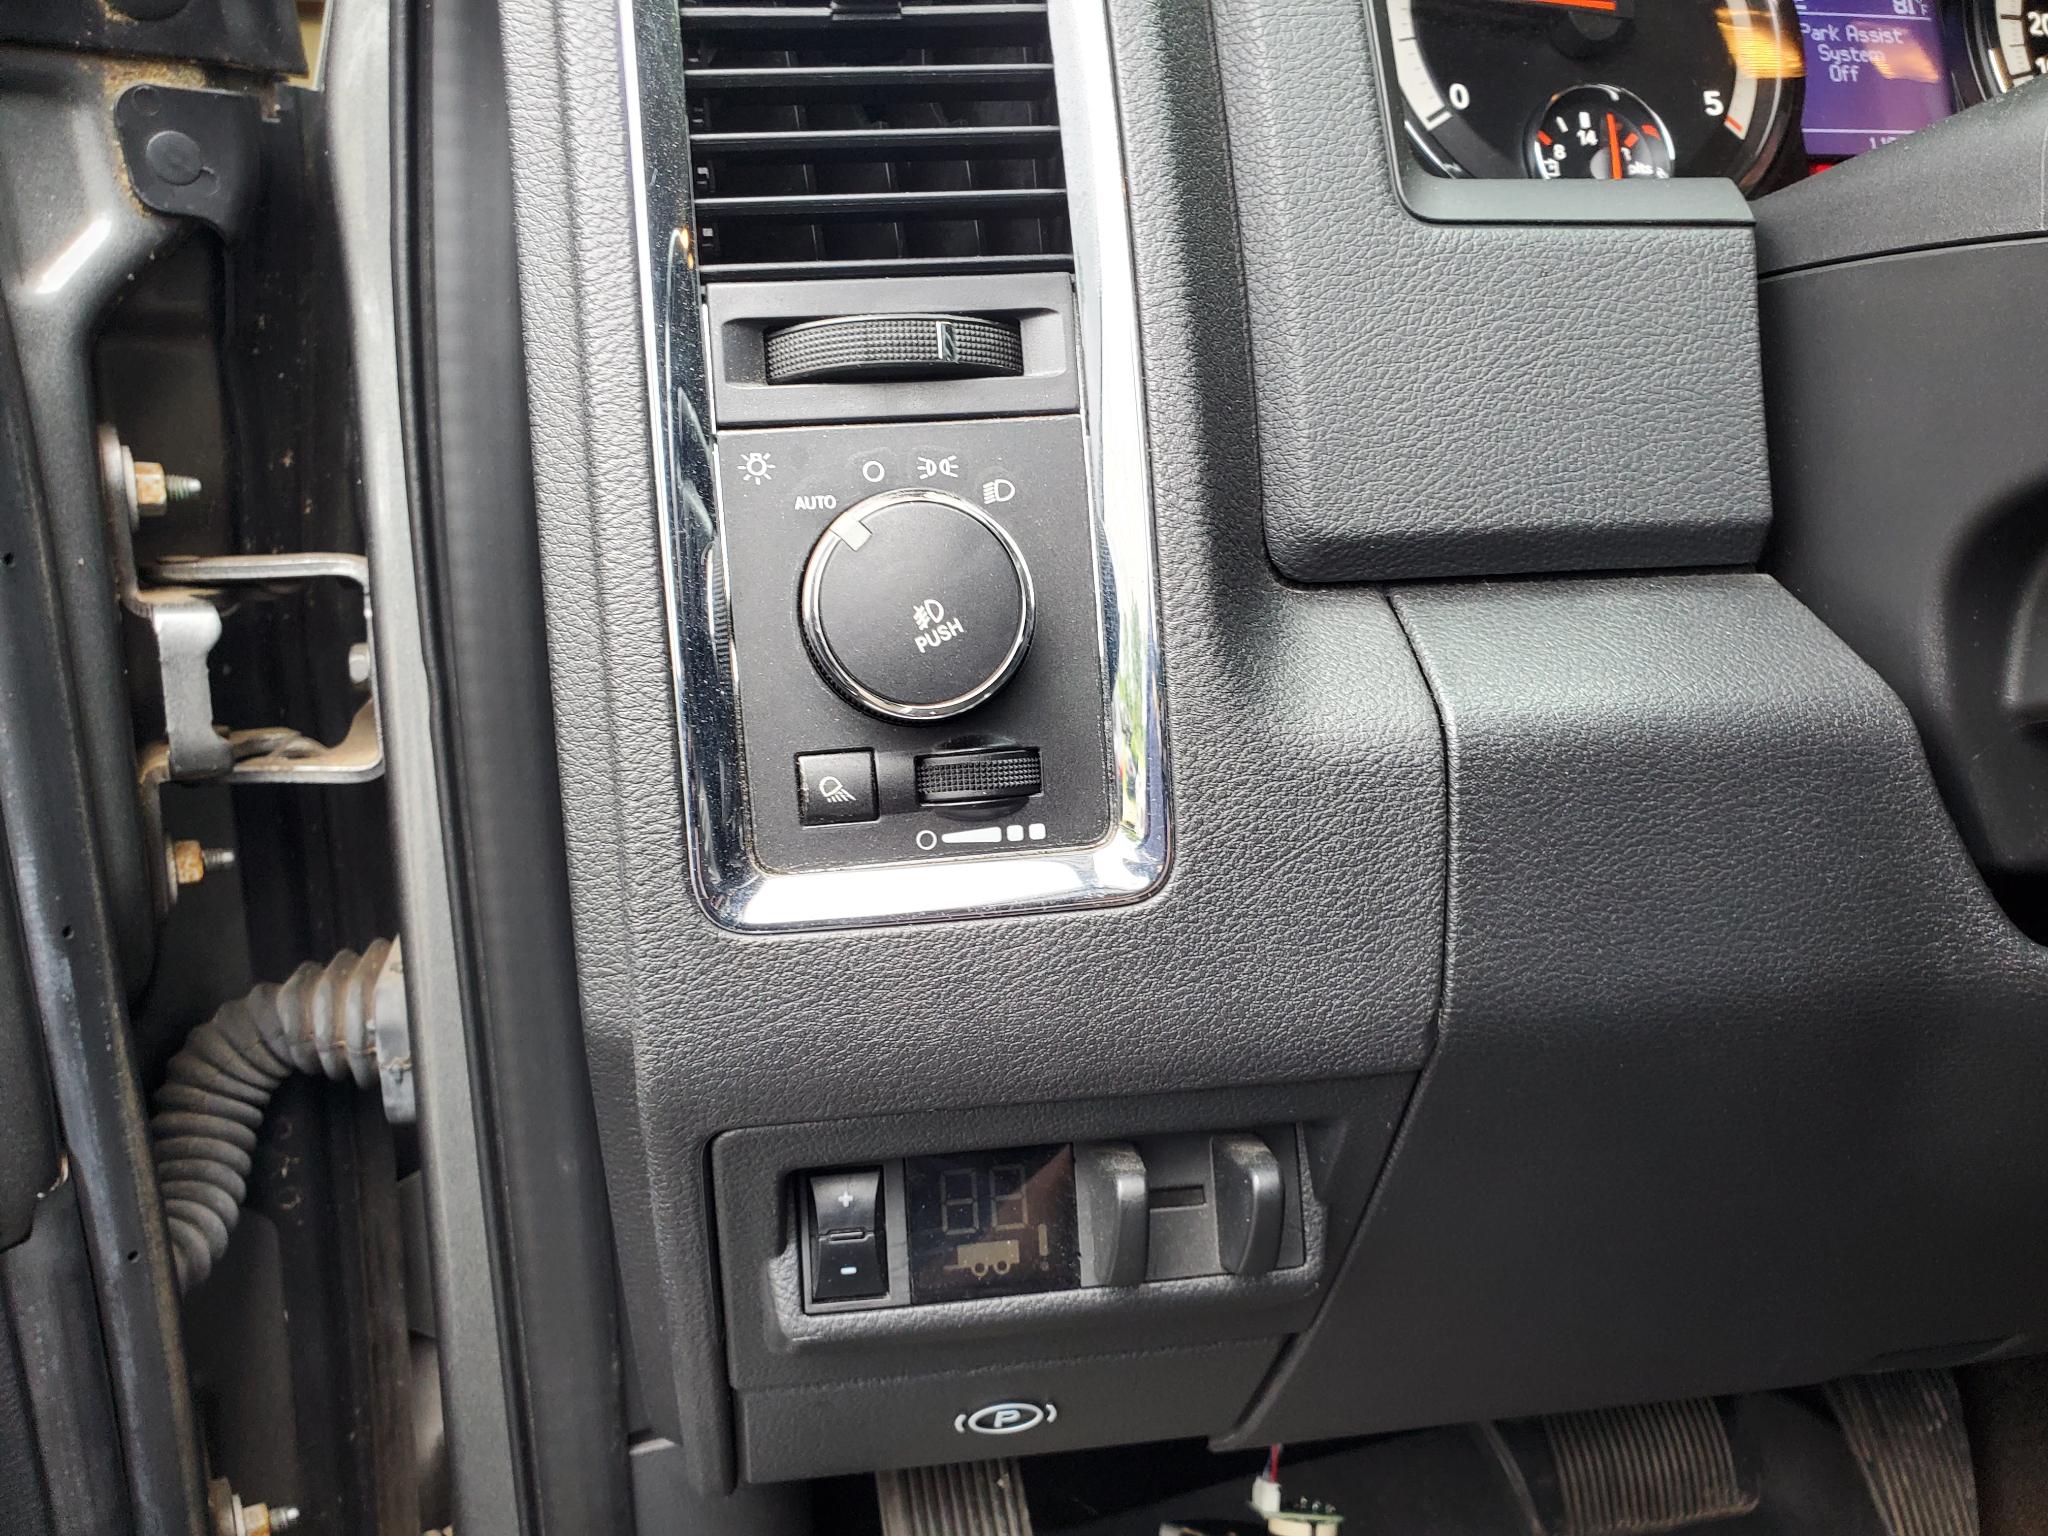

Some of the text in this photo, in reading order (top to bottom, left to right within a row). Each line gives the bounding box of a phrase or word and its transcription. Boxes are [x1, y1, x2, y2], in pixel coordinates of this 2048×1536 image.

[1845, 24, 1904, 44] Assist
[1817, 44, 1885, 65] System
[1828, 64, 1859, 83] Off
[1449, 83, 1470, 110] 0
[1702, 90, 1724, 117] 5
[1576, 129, 1599, 147] 14
[1552, 143, 1568, 161] 8
[794, 494, 837, 511] AUTO
[914, 617, 965, 654] PUSH
